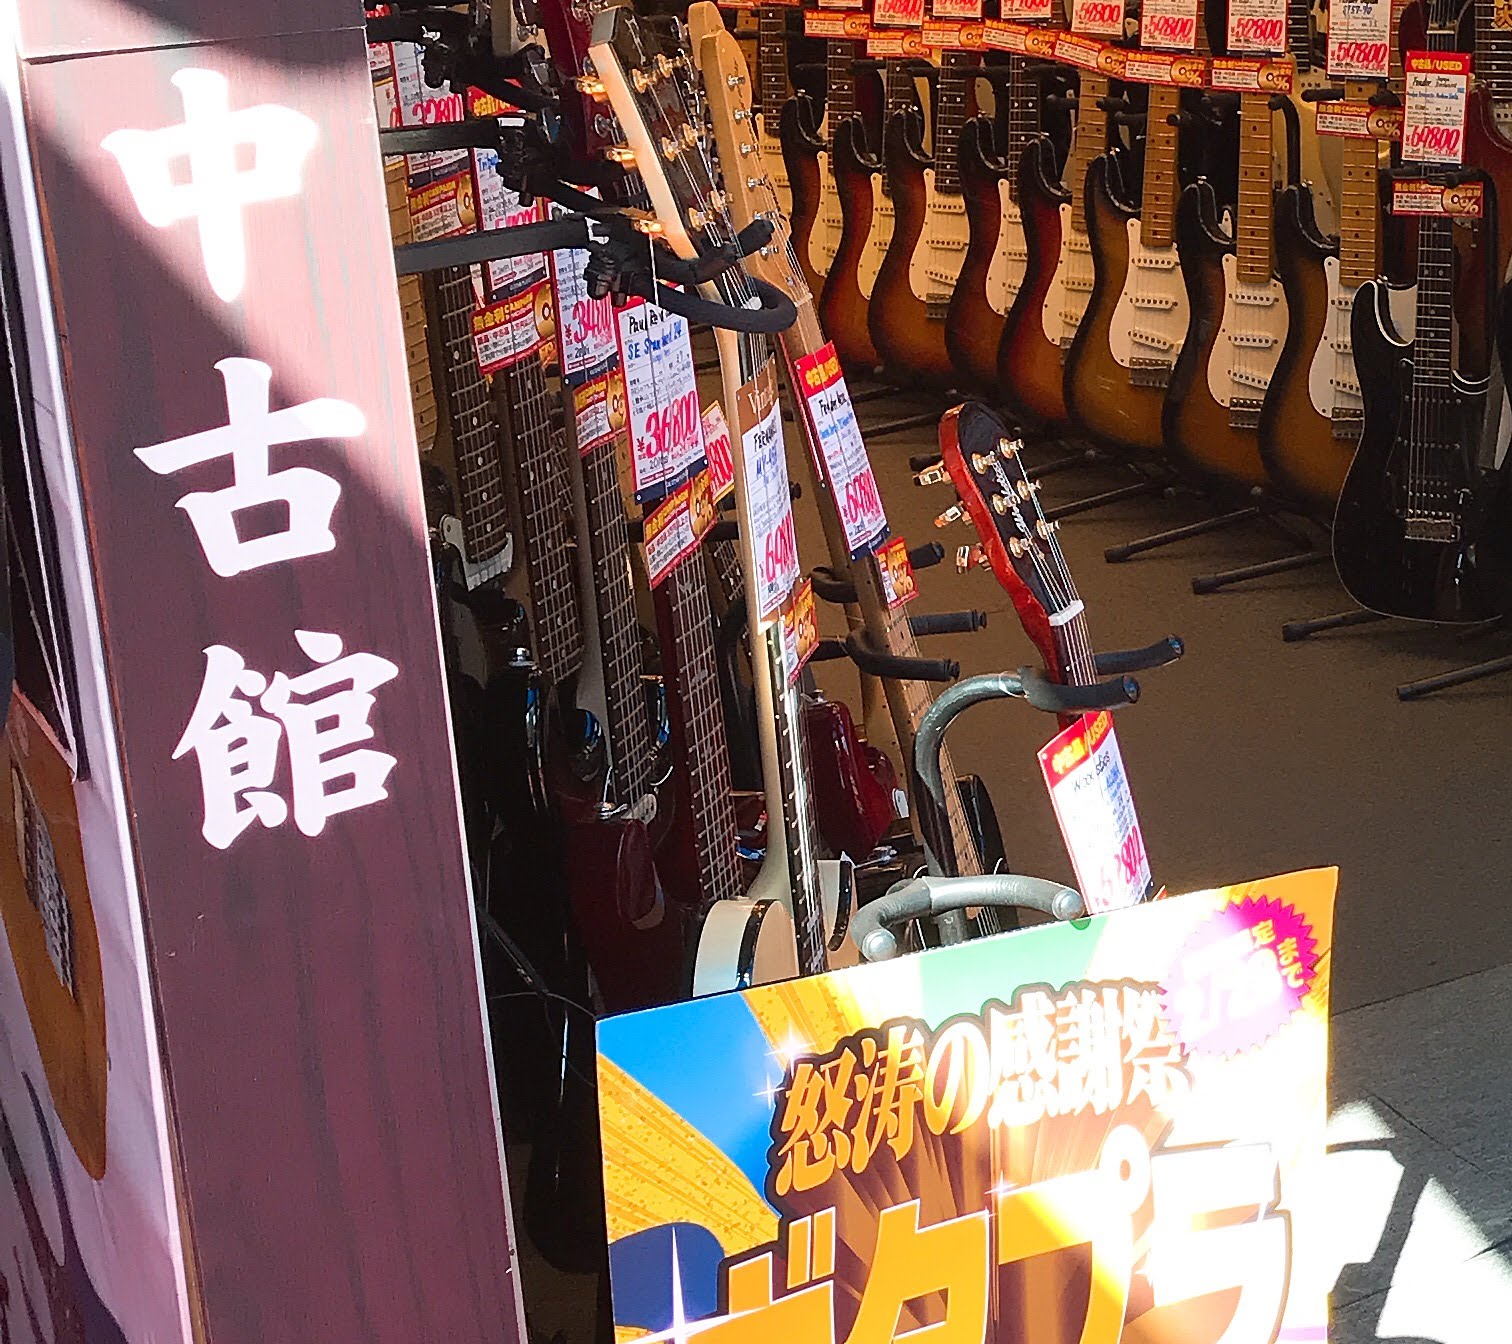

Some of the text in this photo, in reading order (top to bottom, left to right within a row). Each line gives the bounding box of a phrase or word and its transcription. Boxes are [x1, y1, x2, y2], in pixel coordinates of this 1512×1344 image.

[774, 981, 1192, 1196] 怒涛の感謝祭
